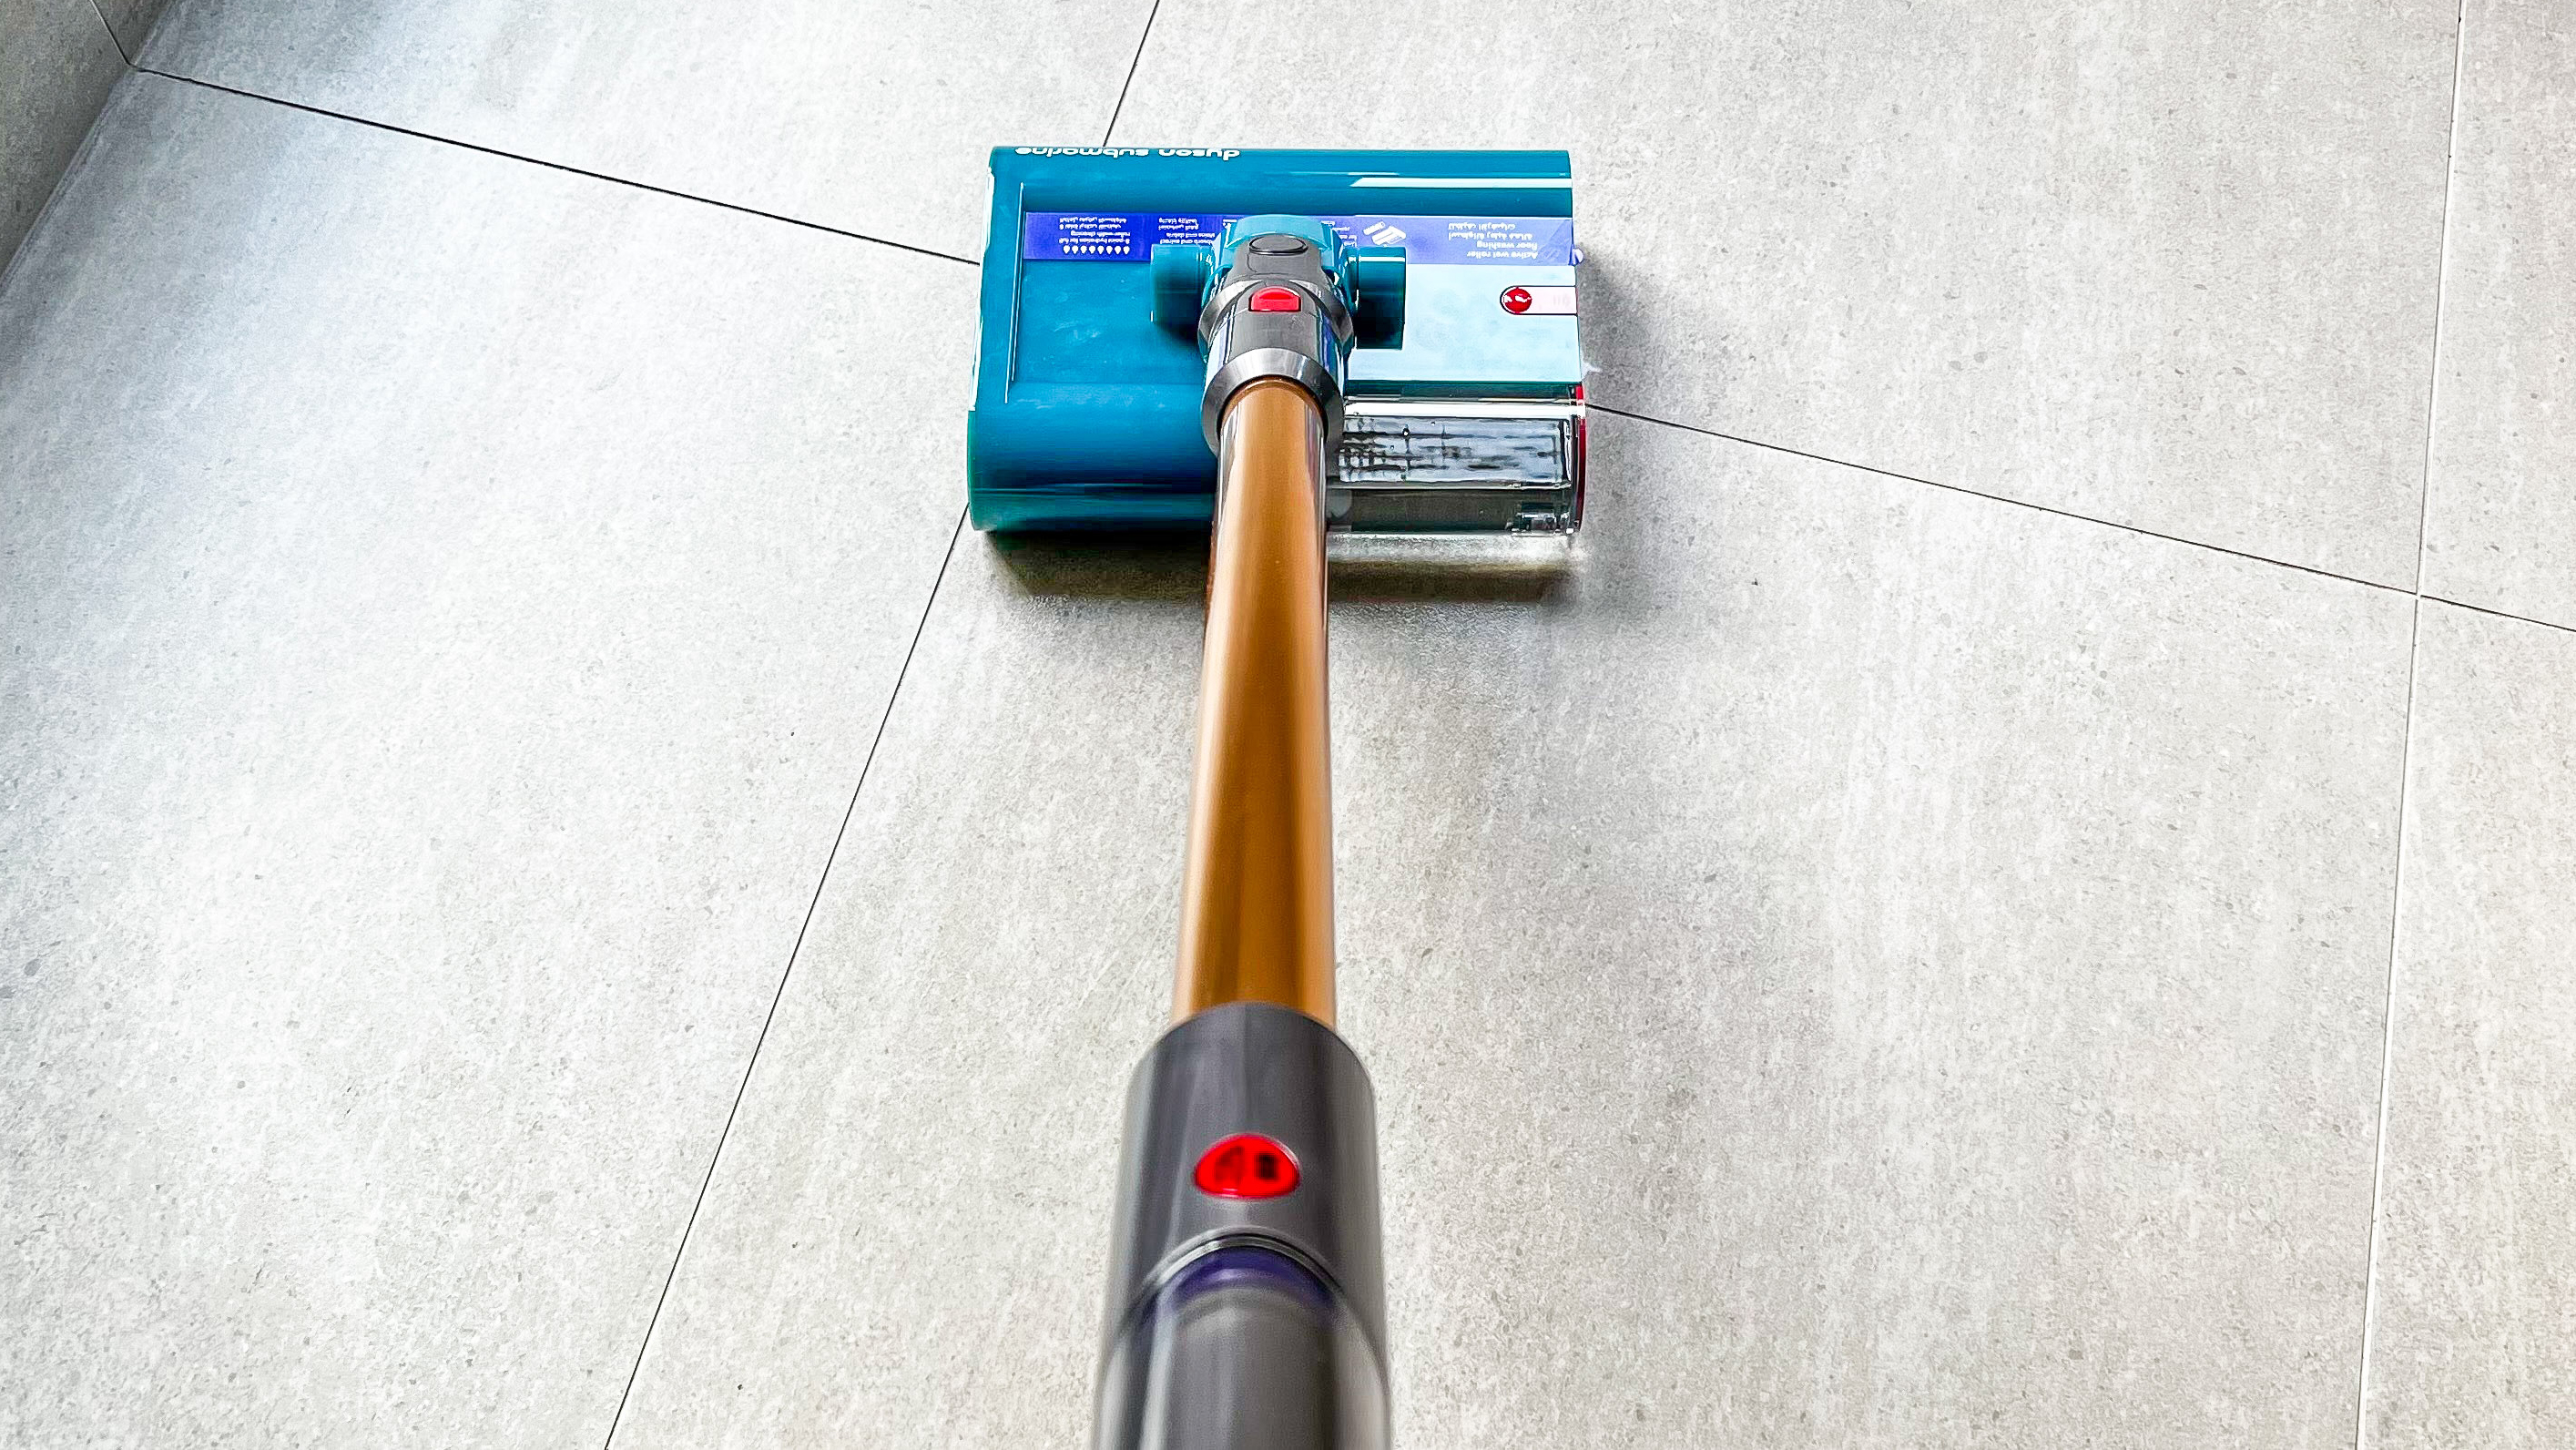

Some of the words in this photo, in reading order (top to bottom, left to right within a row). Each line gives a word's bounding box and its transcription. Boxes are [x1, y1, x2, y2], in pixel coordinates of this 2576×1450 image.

[1014, 148, 1149, 158] submarine
[1158, 148, 1240, 160] dyson
[1477, 240, 1514, 250] washing
[1516, 242, 1538, 250] floor
